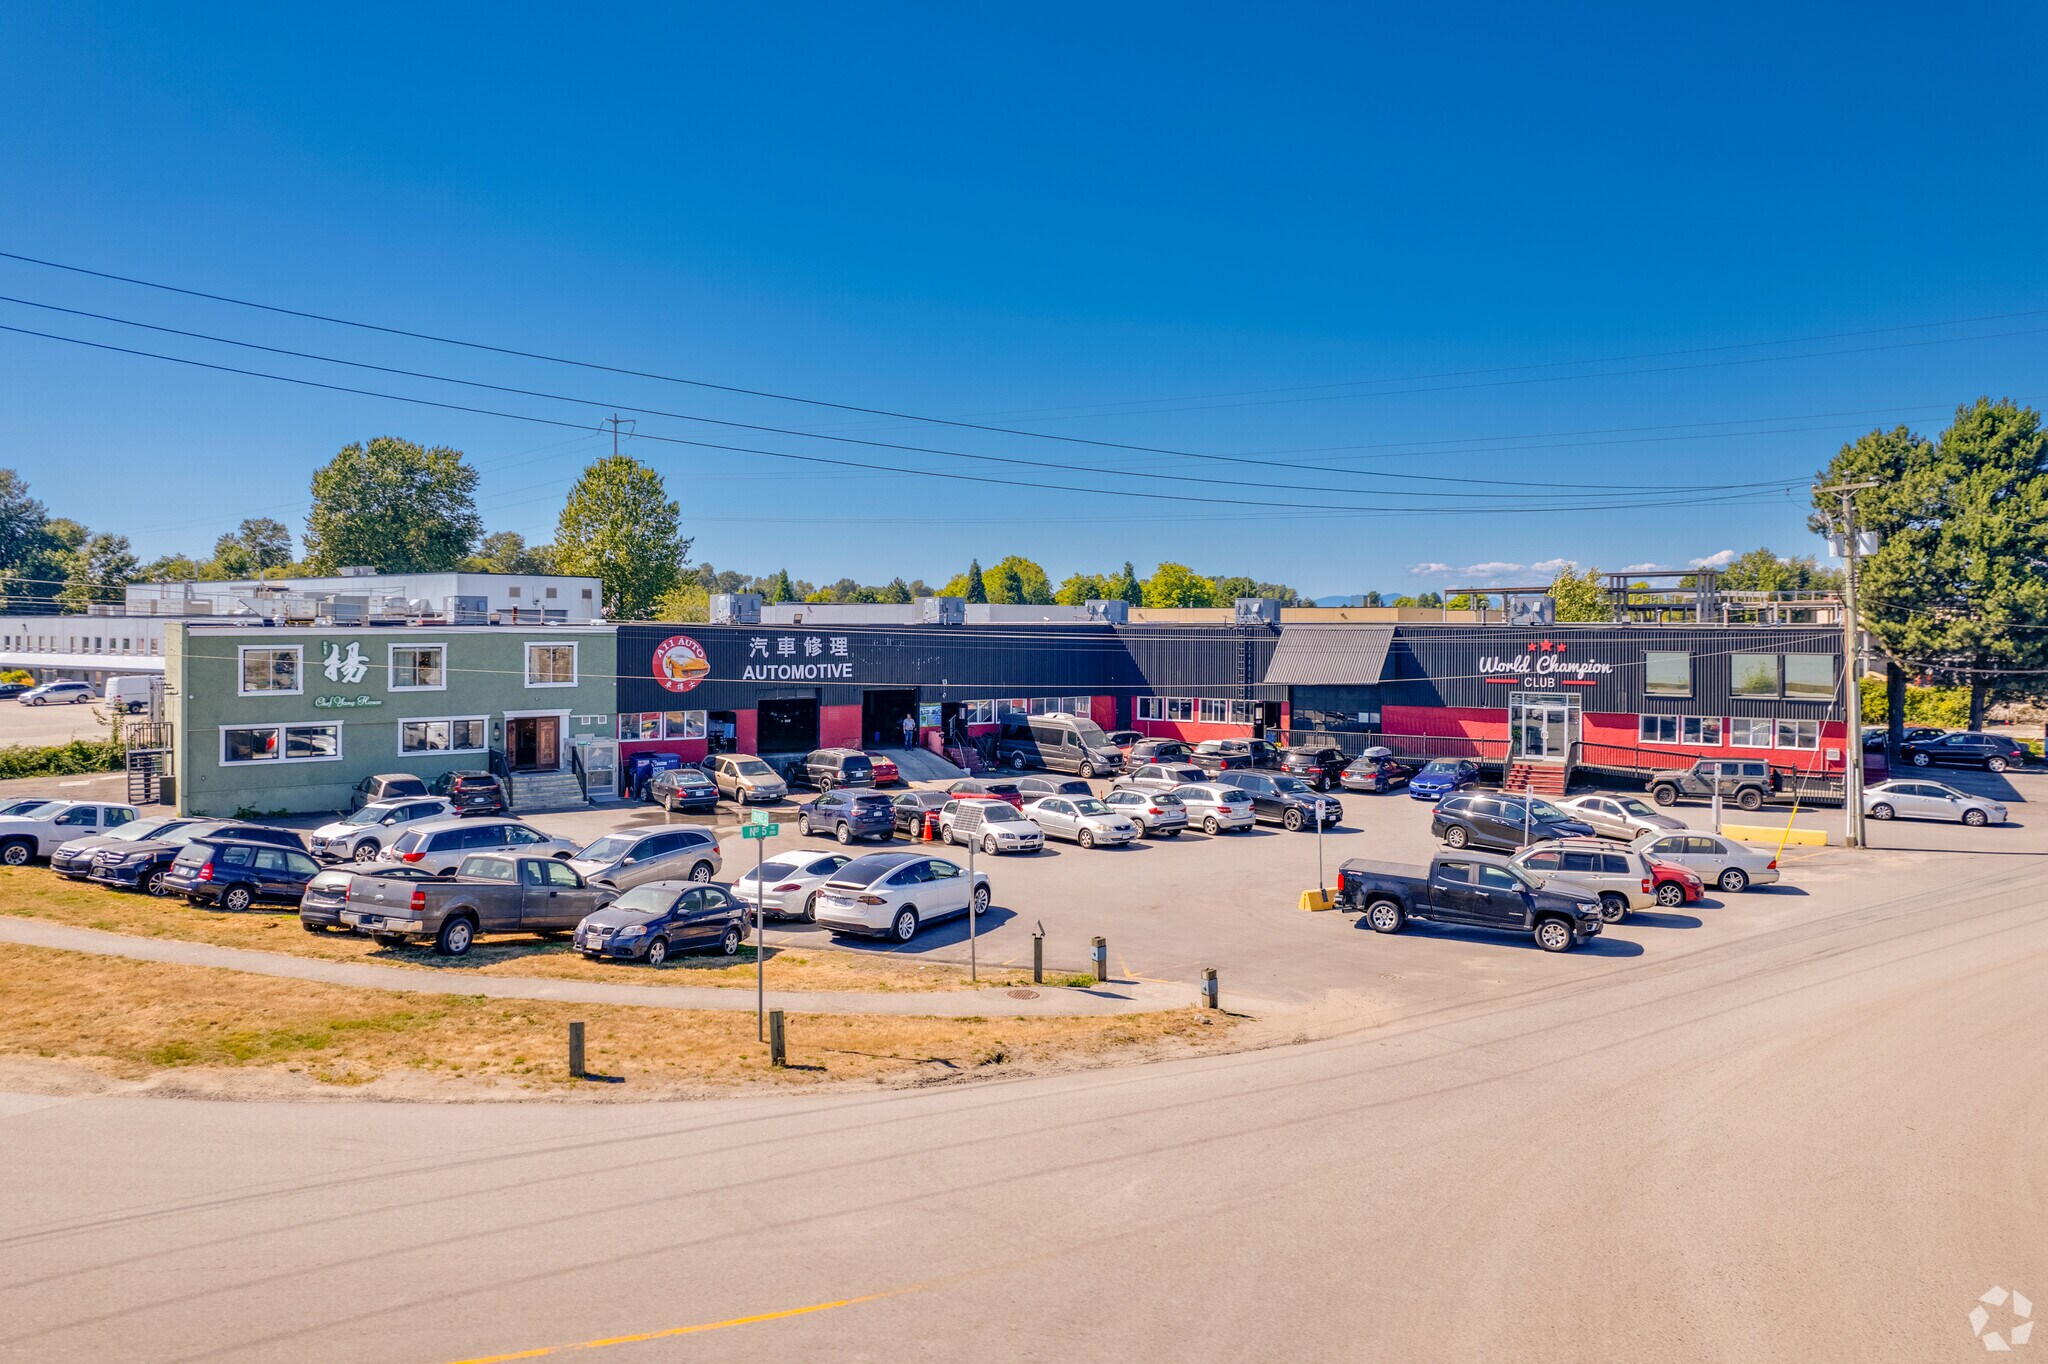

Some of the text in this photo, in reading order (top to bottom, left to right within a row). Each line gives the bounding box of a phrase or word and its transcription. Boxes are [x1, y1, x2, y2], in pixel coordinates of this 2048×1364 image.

[678, 637, 704, 658] AUTO
[749, 636, 848, 658] 汽車修理
[742, 663, 853, 680] AUTOMOTIVE
[1479, 654, 1613, 680] World Champion
[1524, 677, 1555, 688] CLUB
[315, 695, 382, 708] Chef Yang House
